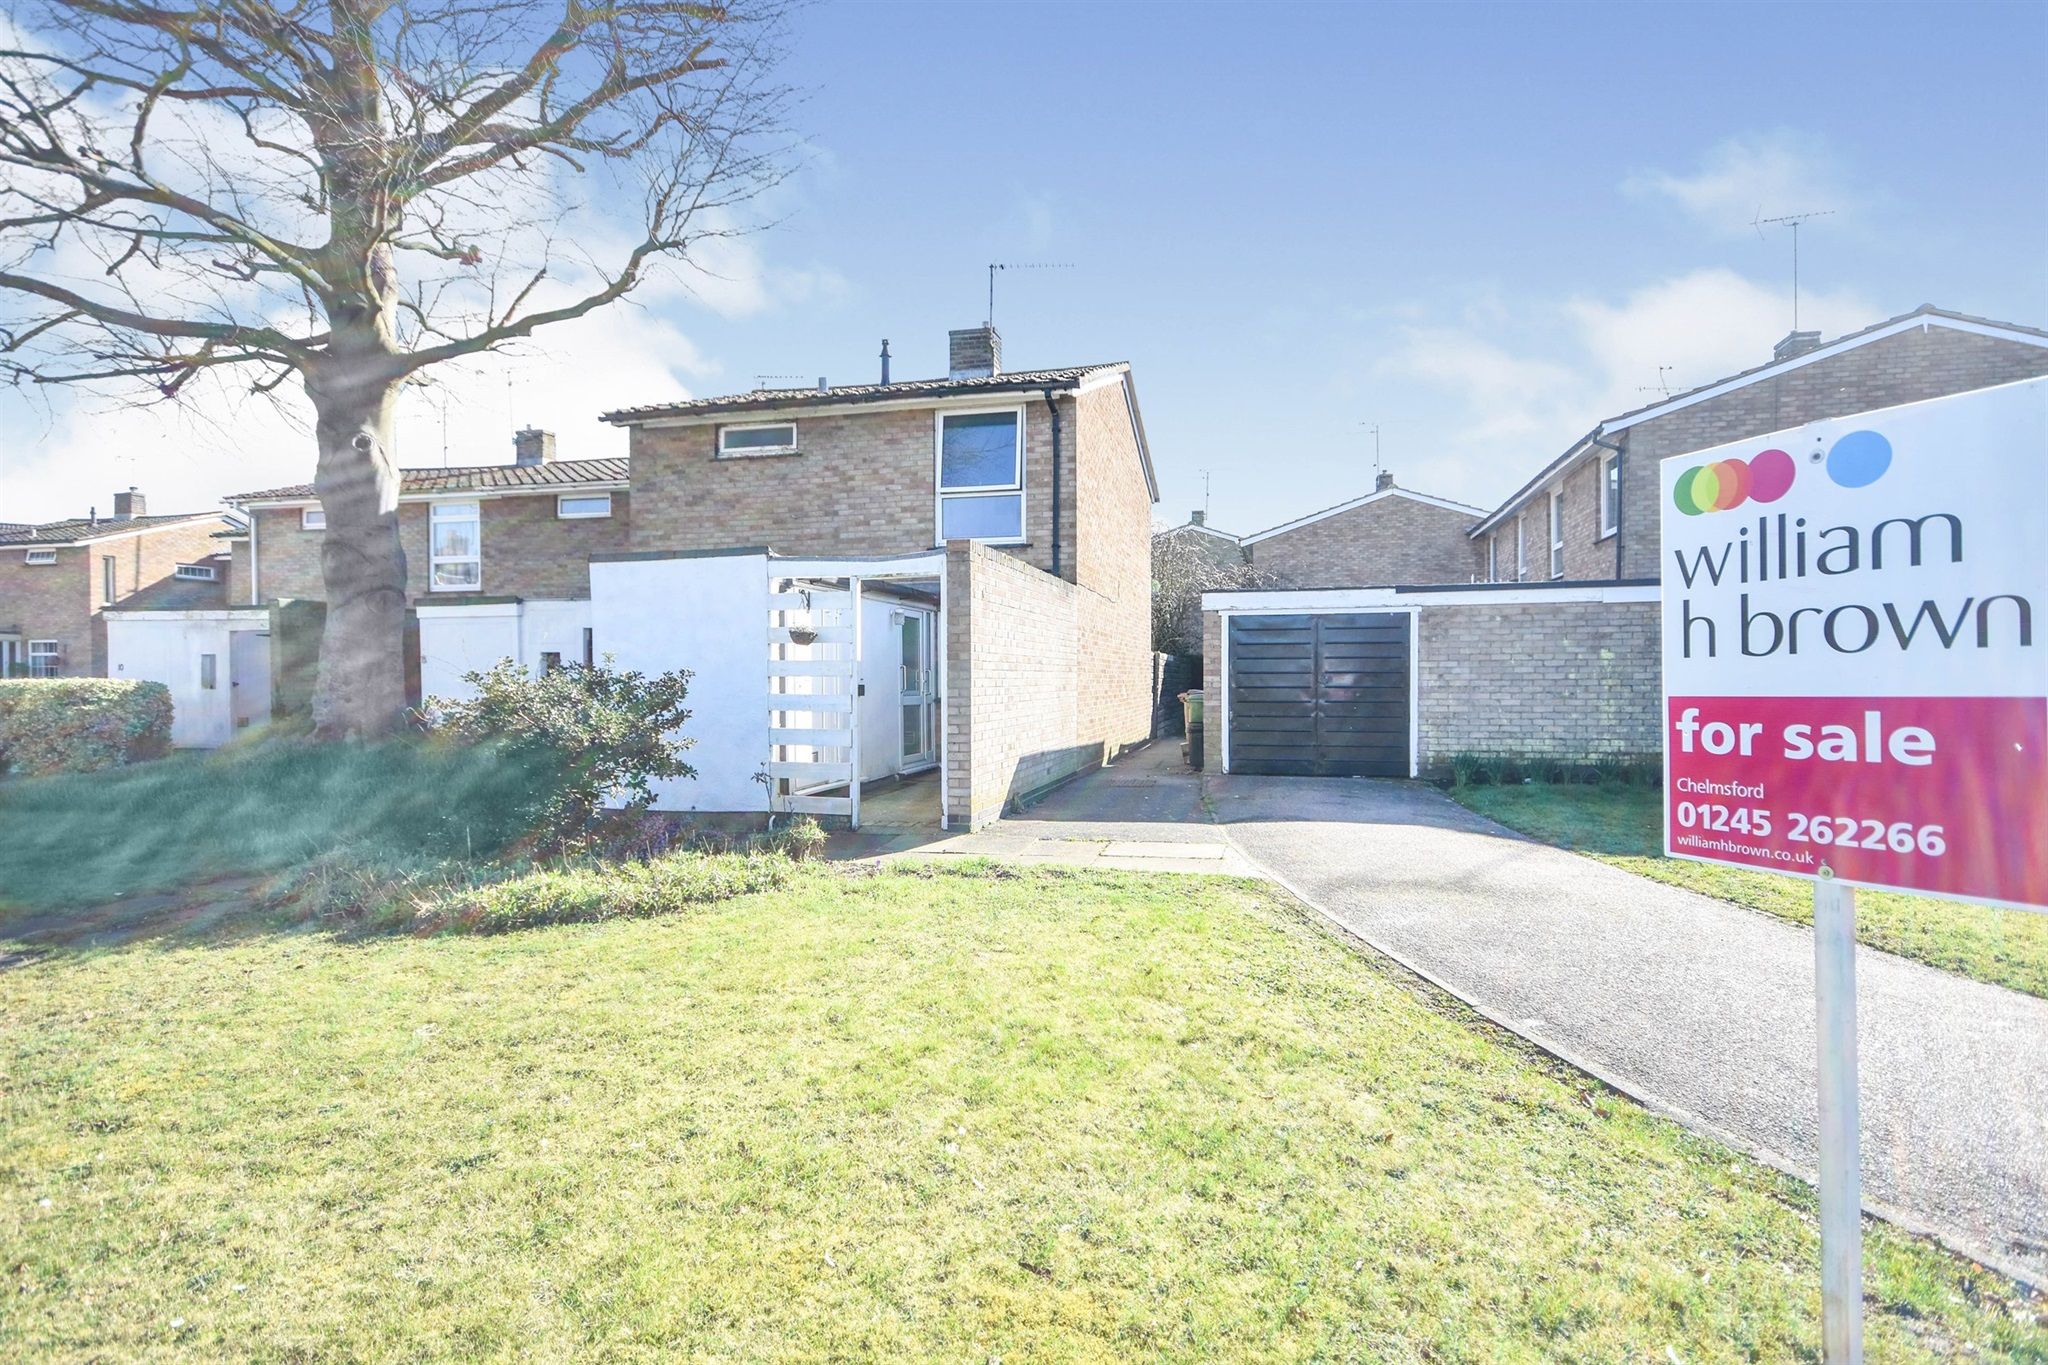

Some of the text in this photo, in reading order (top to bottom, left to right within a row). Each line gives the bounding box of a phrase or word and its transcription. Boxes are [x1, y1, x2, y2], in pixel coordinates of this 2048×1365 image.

[1674, 513, 1963, 589] william
[1683, 593, 2032, 659] h brown
[1675, 707, 1937, 766] for sale
[1677, 777, 1764, 799] Chelmsford
[1677, 801, 1946, 857] 01245 262266
[1677, 835, 1814, 865] williamhbrown.co.uk
